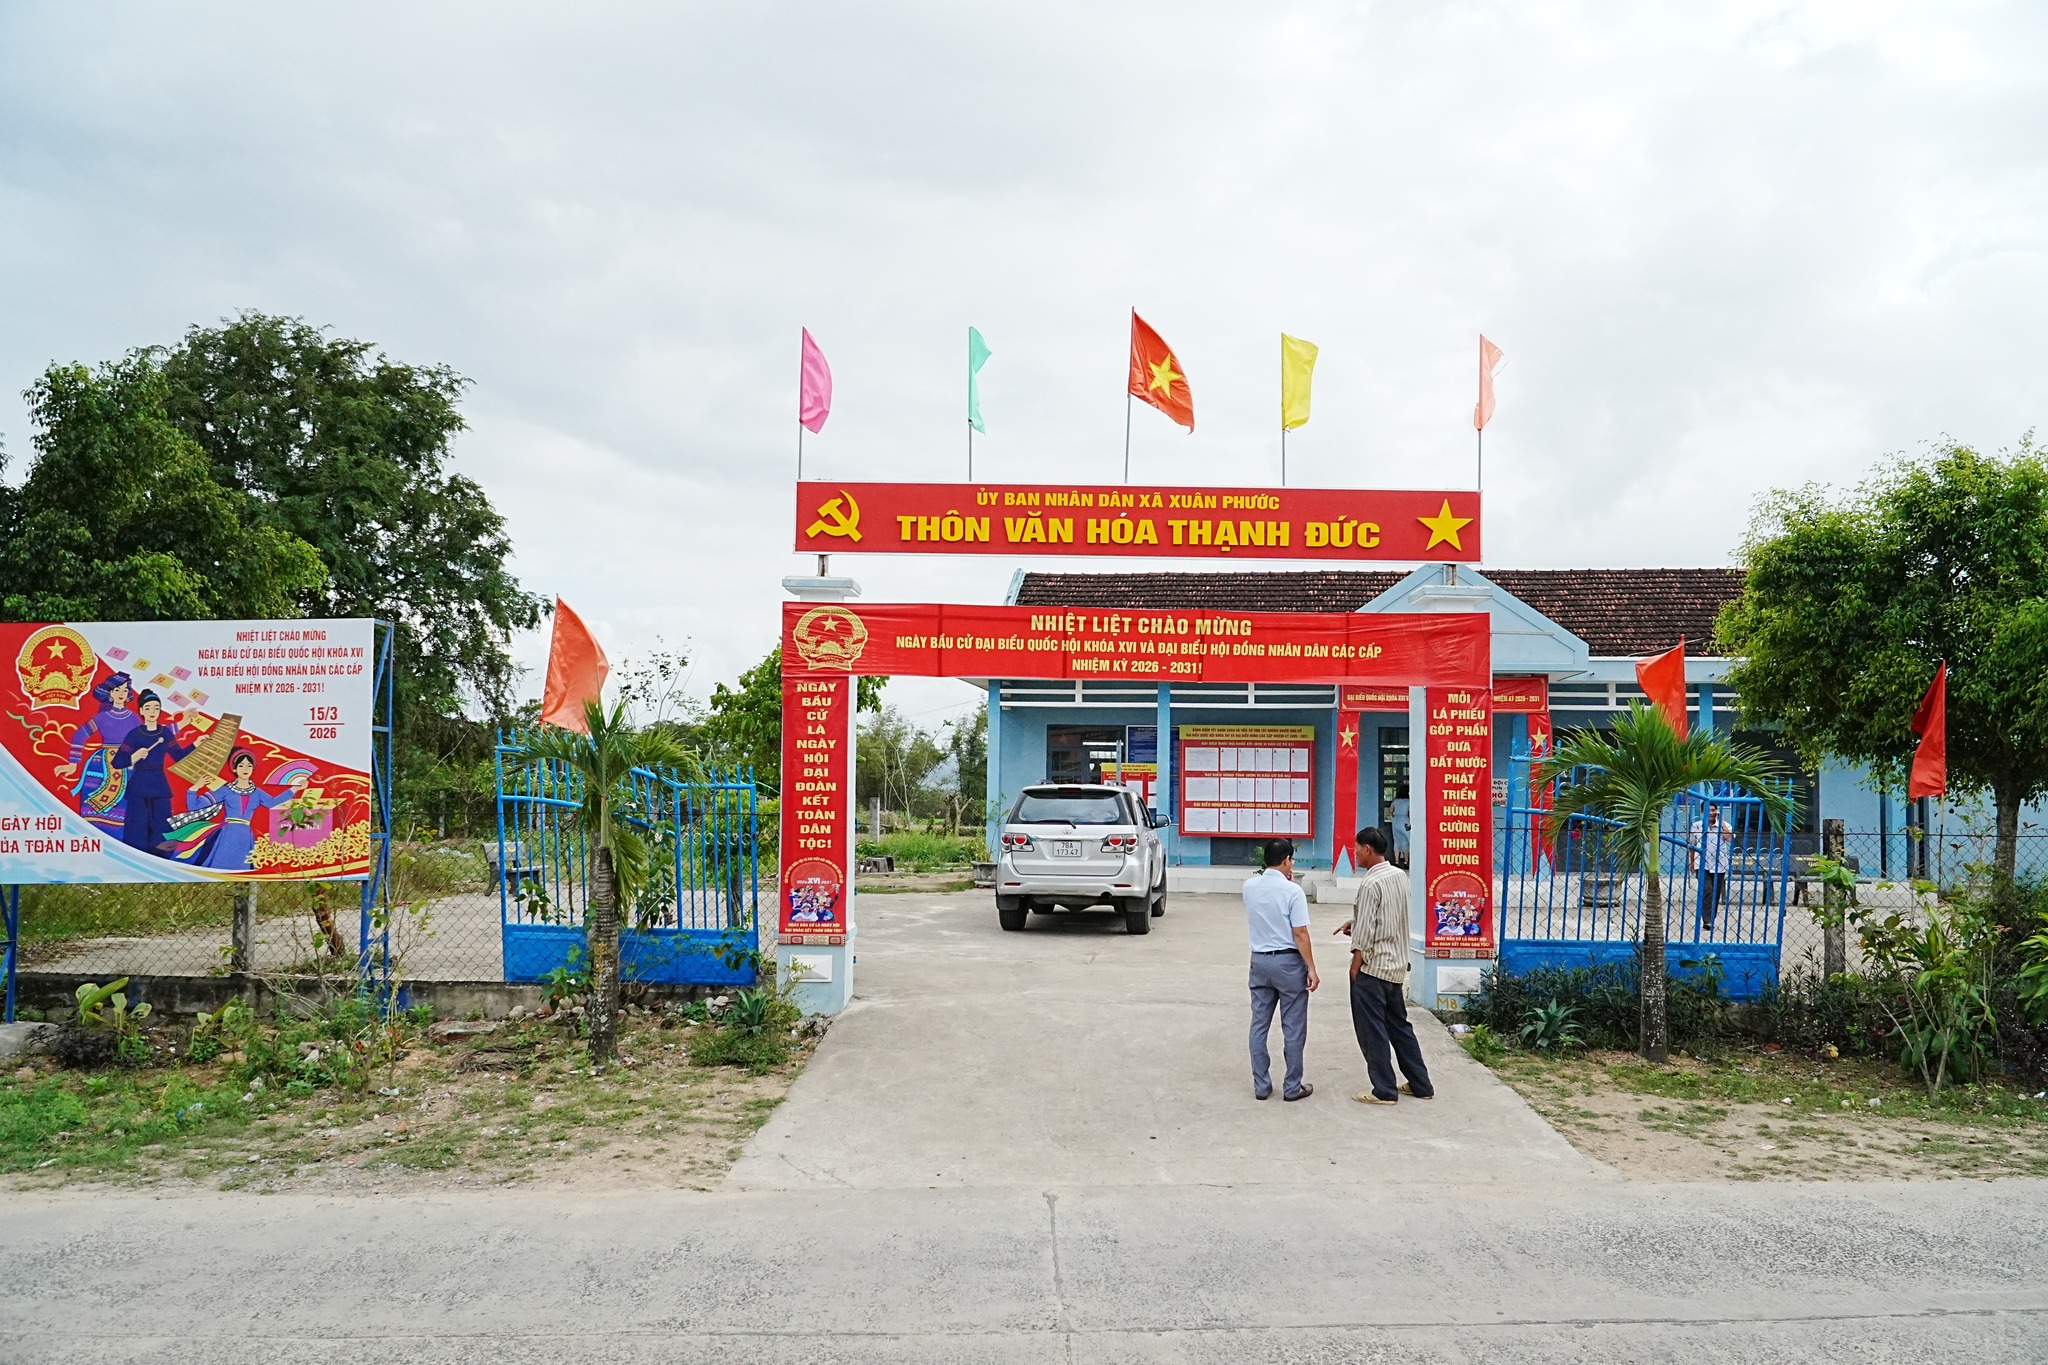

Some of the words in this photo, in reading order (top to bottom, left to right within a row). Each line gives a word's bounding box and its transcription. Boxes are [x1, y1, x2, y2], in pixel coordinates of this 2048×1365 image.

[977, 488, 999, 505] ỦY
[1004, 493, 1040, 506] BAN
[1045, 490, 1093, 507] NHÂN
[1099, 491, 1134, 507] DÂN
[1139, 492, 1164, 508] XÃ
[1169, 492, 1217, 509] XUÂN
[1222, 493, 1280, 510] PHƯỚC
[897, 510, 990, 542] THÔN
[1004, 511, 1074, 543] VĂN
[1087, 512, 1158, 545] HÓA
[1168, 519, 1290, 551] THẠNH
[1304, 515, 1380, 548] ĐỨC
[1031, 613, 1086, 635] NHIỆT
[1092, 614, 1132, 636] LIỆT
[1138, 615, 1188, 635] CHÀO
[1195, 616, 1251, 636] MỪNG
[236, 630, 259, 643] NHIỆT
[261, 629, 276, 643] LIỆT
[280, 629, 300, 641] CHÀO
[303, 629, 326, 641] MỪNG
[896, 634, 927, 648] NGÀY
[930, 633, 953, 648] BẦU
[957, 634, 974, 649] CỬ
[975, 637, 994, 652] ĐẠI
[998, 634, 1024, 650] BIỂU
[1027, 636, 1058, 651] QUỐC
[1062, 638, 1080, 654] HỘI
[1084, 638, 1115, 652] KHÓA
[1118, 642, 1136, 653] XVI
[1140, 640, 1154, 654] VÀ
[1158, 642, 1177, 656] ĐẠI
[1181, 639, 1207, 655] BIỂU
[1210, 642, 1229, 657] HỘI
[1233, 641, 1265, 656] ĐỒNG
[1268, 643, 1300, 657] NHÂN
[1304, 643, 1328, 657] DÂN
[1332, 644, 1355, 658] CÁC
[1358, 642, 1382, 658] CẤP
[198, 647, 219, 659] NGÀY
[240, 645, 251, 659] CỬ
[253, 648, 266, 661] ĐẠI
[268, 645, 286, 658] BIỂU
[288, 645, 309, 658] QUỐC
[312, 645, 324, 660] HỘI
[327, 645, 348, 657] KHÓA
[351, 647, 363, 657] XVI
[198, 664, 208, 676] VÀ
[211, 666, 223, 678] ĐẠI
[226, 662, 244, 676] BIỂU
[247, 664, 259, 678] HỘI
[286, 663, 308, 675] NHÂN
[310, 663, 326, 675] DÂN
[328, 662, 344, 674] CÁC
[347, 661, 363, 674] CẤP
[1072, 657, 1110, 673] NHIỆM
[1113, 658, 1128, 672] KỲ
[1131, 661, 1159, 672] 2026
[1170, 662, 1202, 674] 2031!
[235, 681, 261, 695] NHIỆM
[264, 681, 273, 693] KỲ
[276, 683, 294, 693] 2026
[302, 683, 324, 692] 2031!
[797, 682, 837, 692] NGÀY
[1448, 691, 1470, 704] MỖI
[310, 707, 338, 720] 15/3
[807, 710, 828, 721] CỬ
[1433, 708, 1447, 719] LÁ
[1451, 707, 1485, 719] PHIẾU
[309, 727, 337, 739] 2026
[807, 724, 826, 735] LÀ
[1430, 723, 1453, 735] GÓP
[796, 738, 836, 749] NGÀY
[1447, 741, 1471, 752] ĐƯA
[804, 752, 828, 765] HỘI
[1430, 754, 1453, 767] ĐẤT
[1456, 756, 1487, 768] NƯỚC
[803, 768, 828, 778] ĐẠI
[1444, 772, 1475, 784] PHÁT
[795, 780, 836, 792] ĐOÀN
[1442, 786, 1476, 800] TRIỂN
[802, 794, 830, 806] KẾT
[796, 809, 835, 820] TOÀN
[1443, 804, 1476, 816] HÙNG
[0, 814, 30, 830] GÀY
[35, 814, 62, 833] HỘI
[800, 823, 831, 834] DÂN
[1439, 820, 1479, 832] CƯỜNG
[0, 837, 19, 853] ỦA
[25, 837, 64, 853] TOÀN
[70, 836, 100, 852] DÂN
[798, 838, 832, 850] TỘC!
[1442, 838, 1476, 850] THỊNH
[1440, 854, 1479, 866] VƯỢNG
